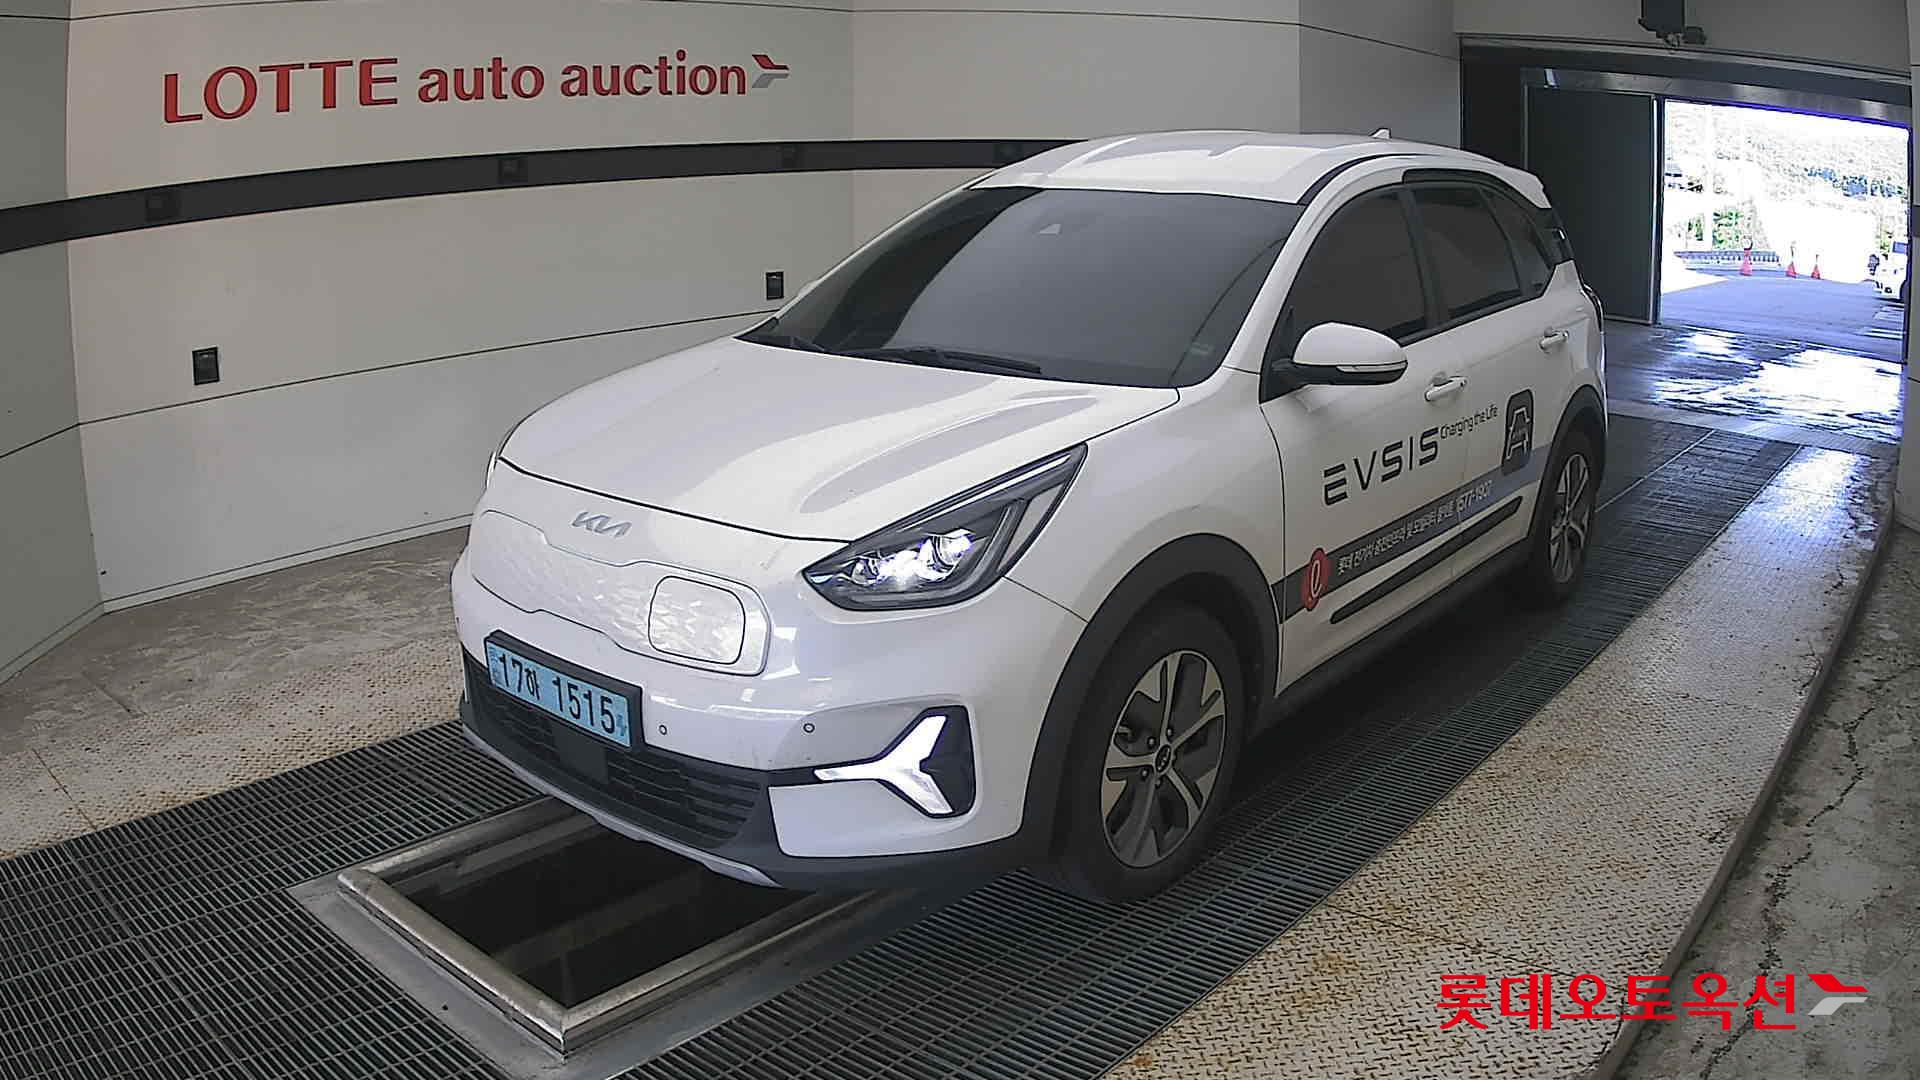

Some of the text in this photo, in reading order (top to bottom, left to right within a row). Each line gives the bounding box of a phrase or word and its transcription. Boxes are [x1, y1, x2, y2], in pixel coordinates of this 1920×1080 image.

[164, 49, 747, 124] LOTTE auto auction
[1440, 416, 1474, 440] Charging
[1323, 426, 1439, 506] EVSIS
[571, 511, 633, 538] KIA
[552, 676, 616, 735] 1515
